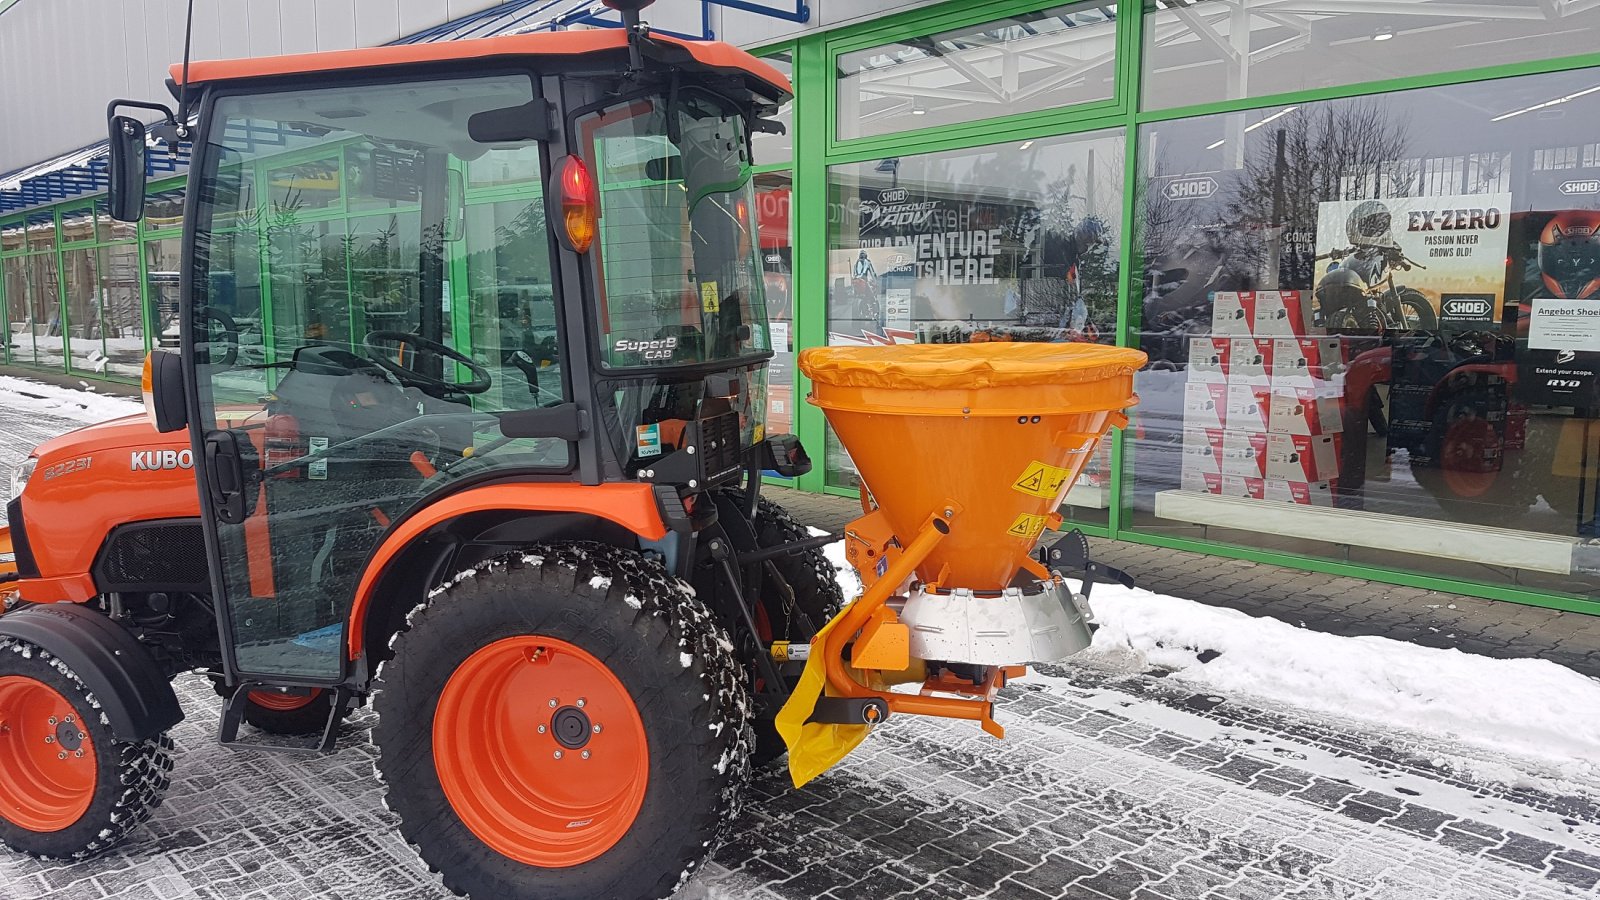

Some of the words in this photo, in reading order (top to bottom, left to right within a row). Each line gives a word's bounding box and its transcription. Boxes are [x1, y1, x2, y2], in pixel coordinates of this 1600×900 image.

[1170, 181, 1210, 196] SHOEI
[1565, 182, 1598, 193] SHOEI
[882, 190, 905, 202] SHOEI
[880, 210, 932, 226] ADV
[1407, 208, 1500, 231] EX-ZERO
[1286, 232, 1313, 243] COME
[1425, 236, 1454, 245] PASSION
[1456, 235, 1478, 245] NEVER
[1286, 243, 1292, 253] &
[1430, 248, 1454, 257] GROWS
[1456, 247, 1472, 257] OLD!
[1450, 302, 1485, 313] SHOEI
[1538, 308, 1575, 316] Angebot
[615, 337, 677, 351] SuperB
[645, 350, 672, 359] CAB
[131, 449, 196, 471] KUBO
